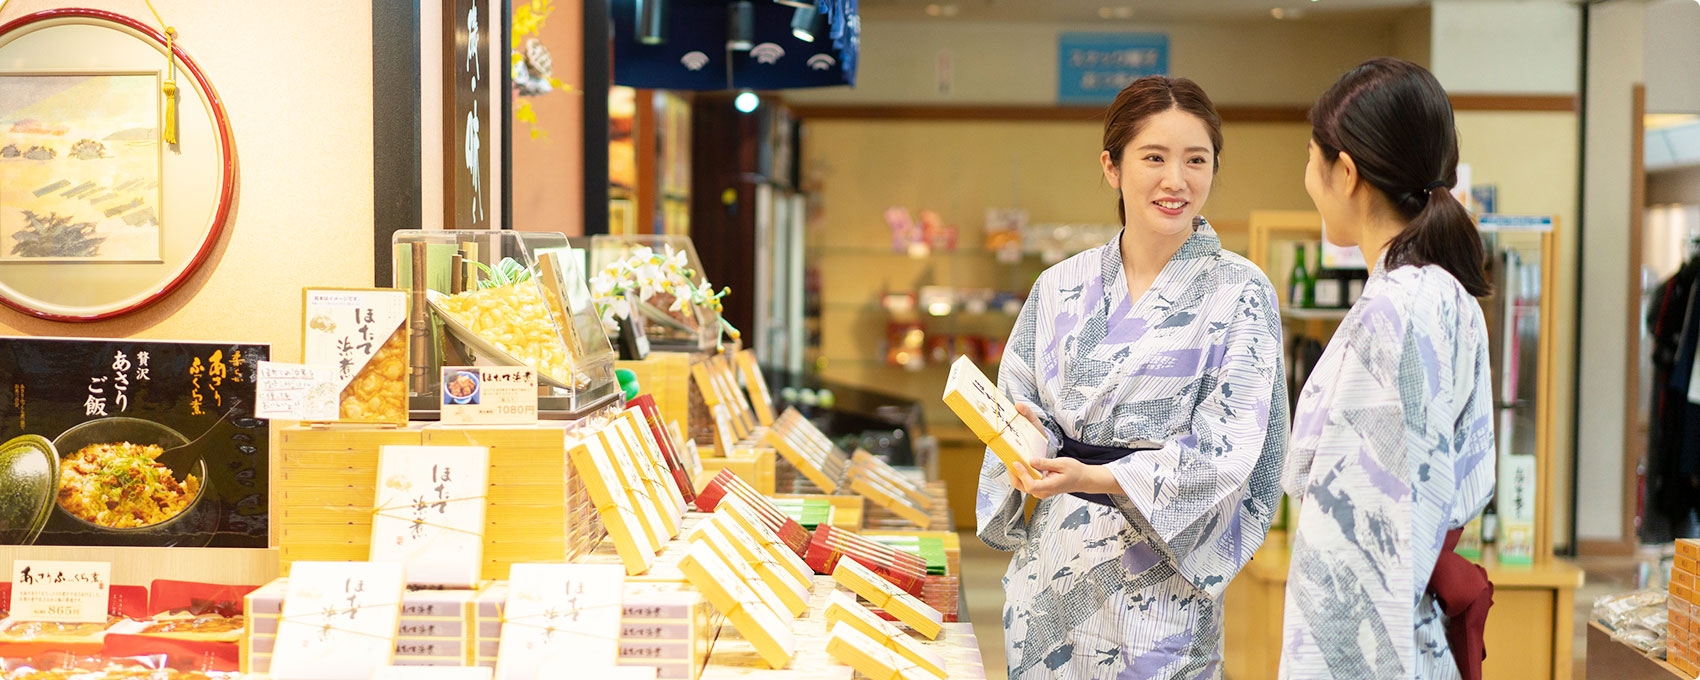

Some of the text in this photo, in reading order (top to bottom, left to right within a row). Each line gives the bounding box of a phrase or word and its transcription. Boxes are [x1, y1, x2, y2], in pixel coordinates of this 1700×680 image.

[355, 308, 375, 355] ほたて
[136, 351, 150, 381] 贅沢
[209, 349, 227, 408] あさり
[229, 350, 246, 383] 柔らか
[336, 336, 354, 380] 浜煮
[482, 371, 532, 383] ほたて浜煮
[83, 376, 108, 416] ご飯
[112, 350, 131, 413] あさり
[189, 356, 206, 416] ふっくら煮
[497, 405, 535, 416] 1080円
[432, 464, 452, 514] ほたて
[409, 495, 428, 540] 浜煮
[48, 606, 80, 616] 865円
[341, 577, 365, 620] ほたて
[563, 579, 585, 622] ほたて
